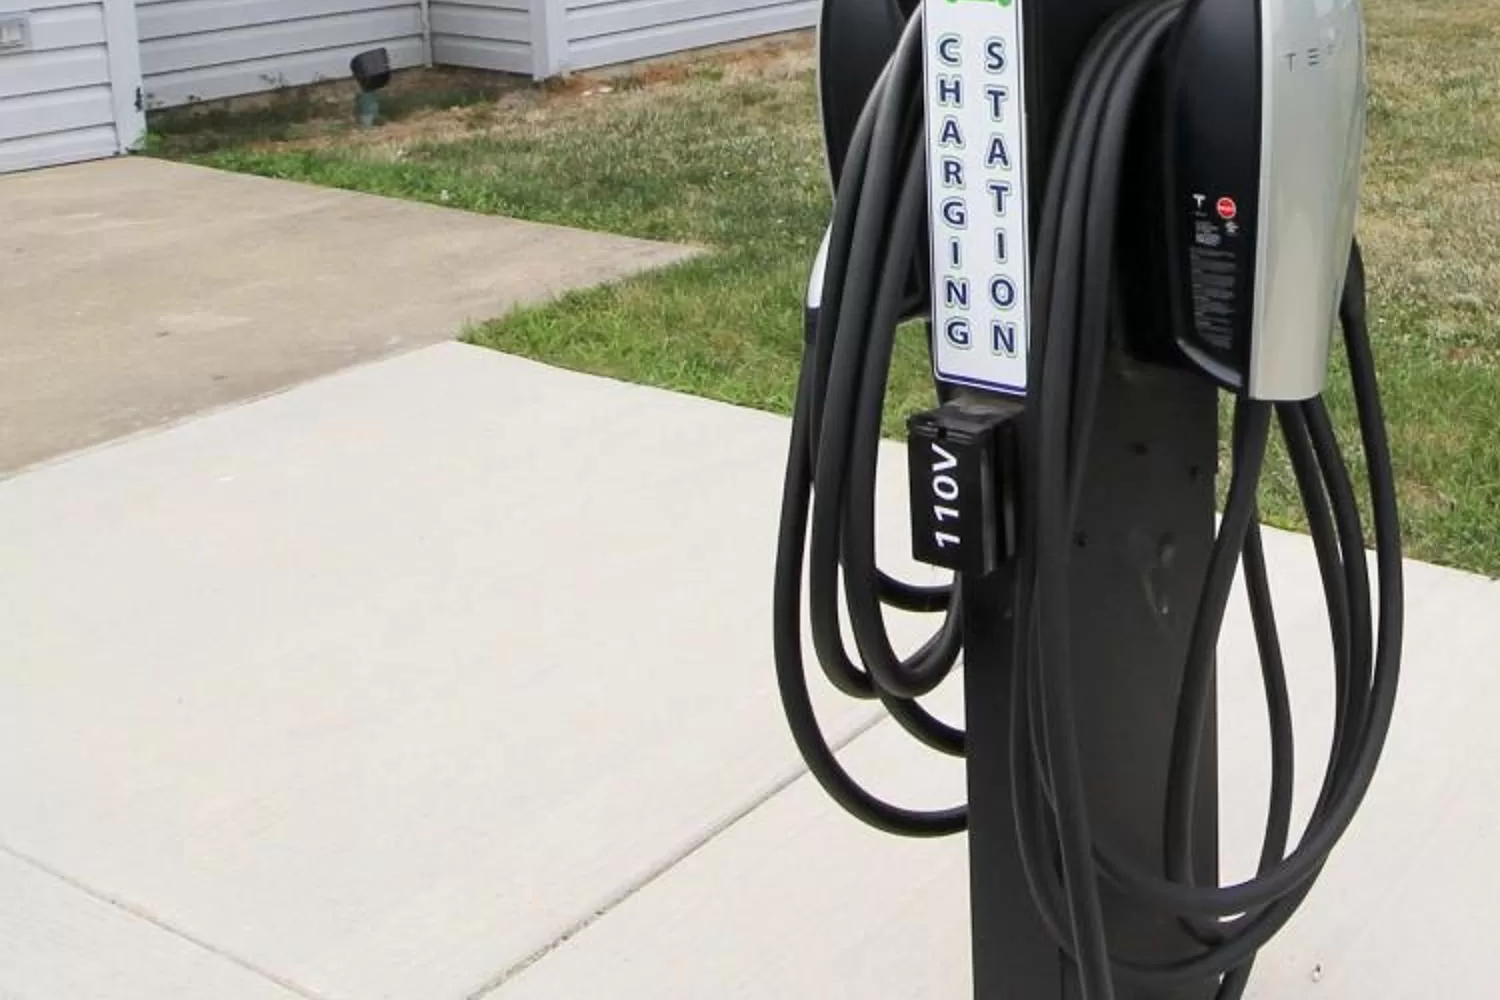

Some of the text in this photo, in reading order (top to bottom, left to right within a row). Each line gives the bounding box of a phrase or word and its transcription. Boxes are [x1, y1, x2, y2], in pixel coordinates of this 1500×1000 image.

[938, 37, 970, 347] CHARGING
[986, 40, 1016, 353] STATION
[931, 443, 961, 547] 110V
